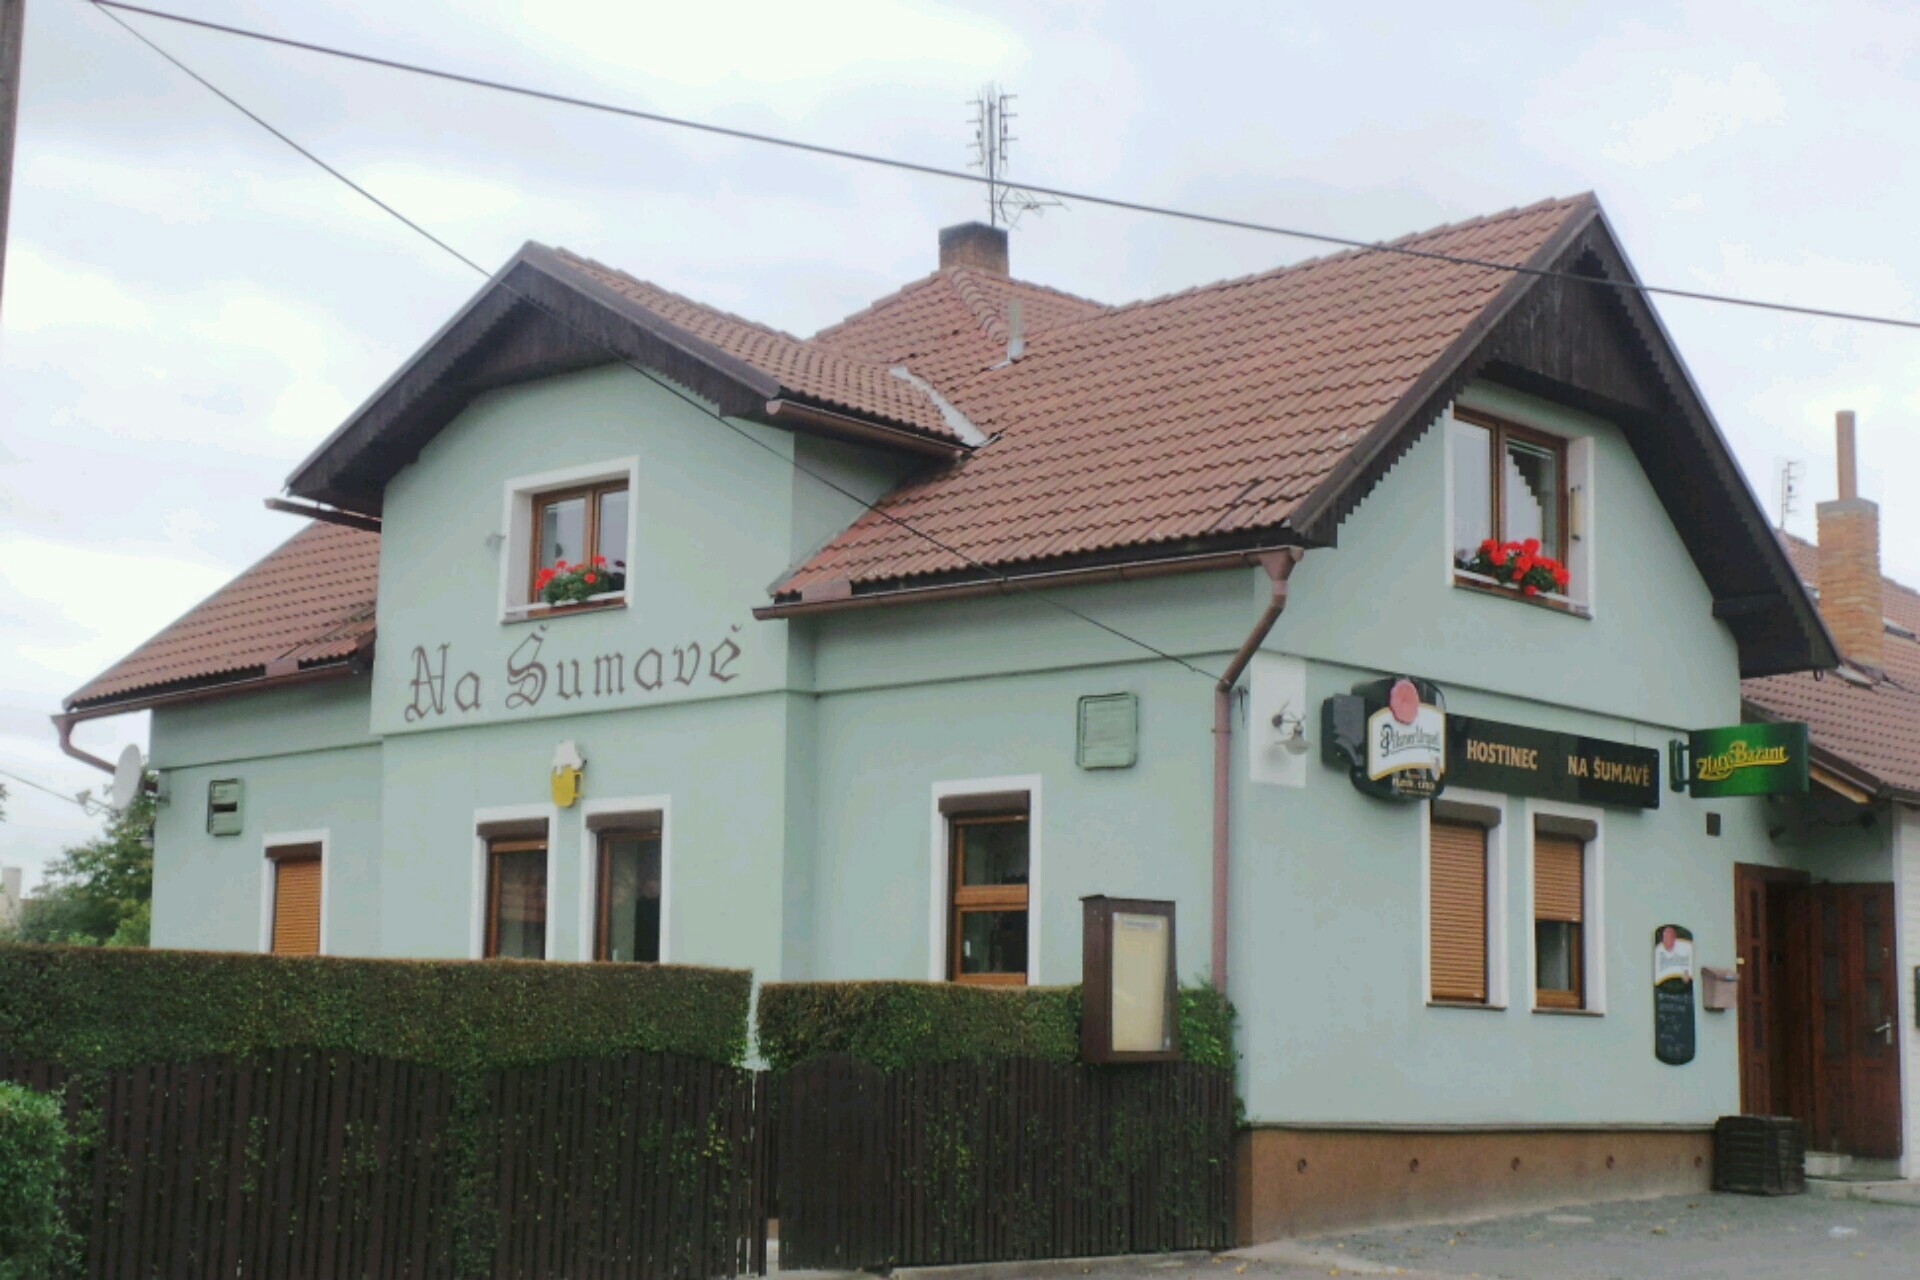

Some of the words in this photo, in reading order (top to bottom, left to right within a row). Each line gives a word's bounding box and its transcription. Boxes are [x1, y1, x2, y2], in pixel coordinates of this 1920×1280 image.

[404, 642, 482, 722] Na
[505, 623, 744, 710] Šumavě
[1466, 738, 1539, 771] HOSTINEC
[1567, 755, 1589, 777] NA
